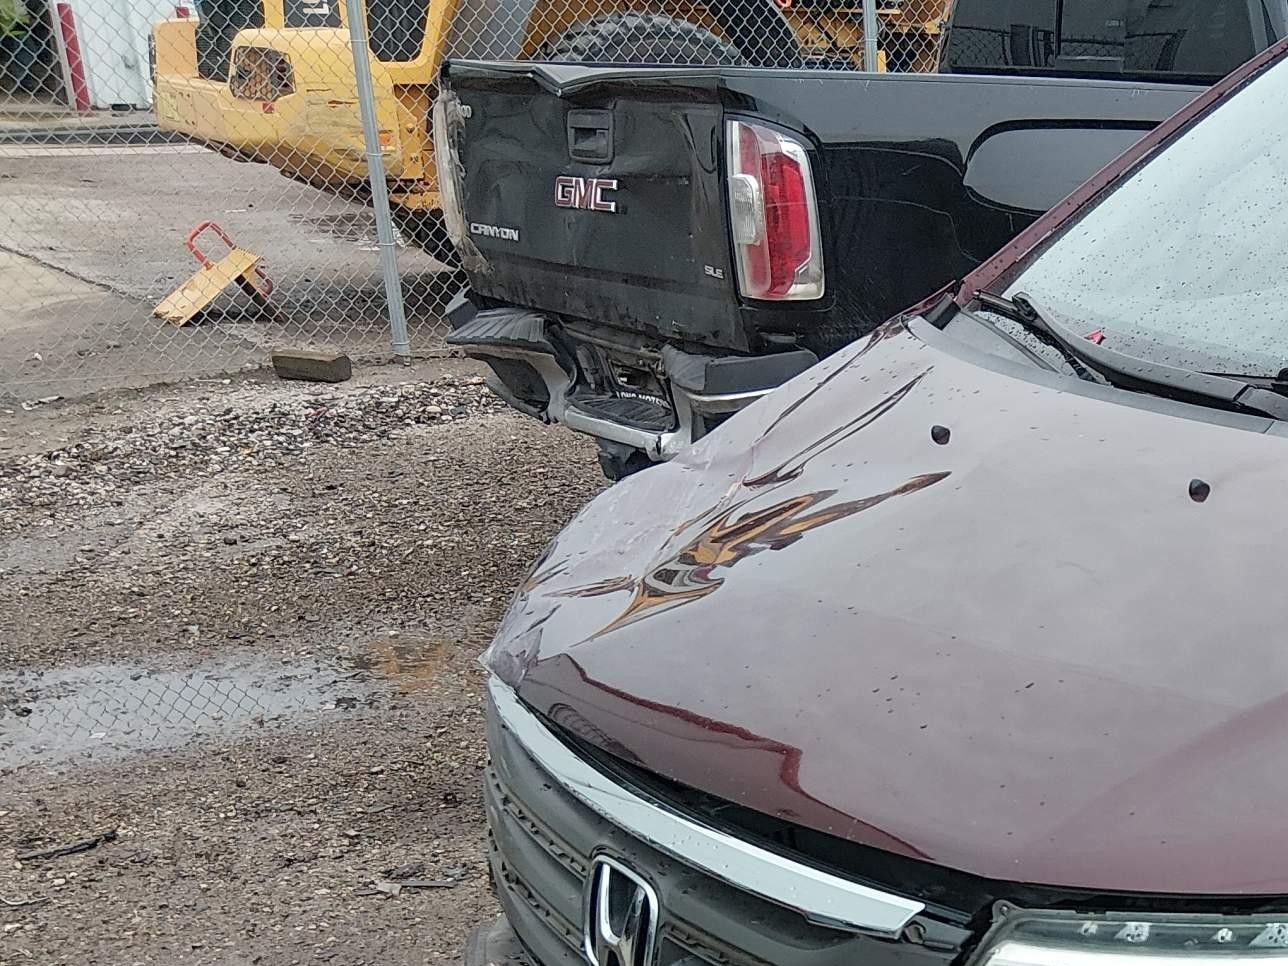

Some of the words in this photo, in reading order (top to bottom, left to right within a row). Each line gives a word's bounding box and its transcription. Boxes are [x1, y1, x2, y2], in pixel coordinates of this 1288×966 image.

[555, 176, 618, 213] GMC
[470, 222, 519, 241] CANYON
[704, 264, 724, 279] SLE
